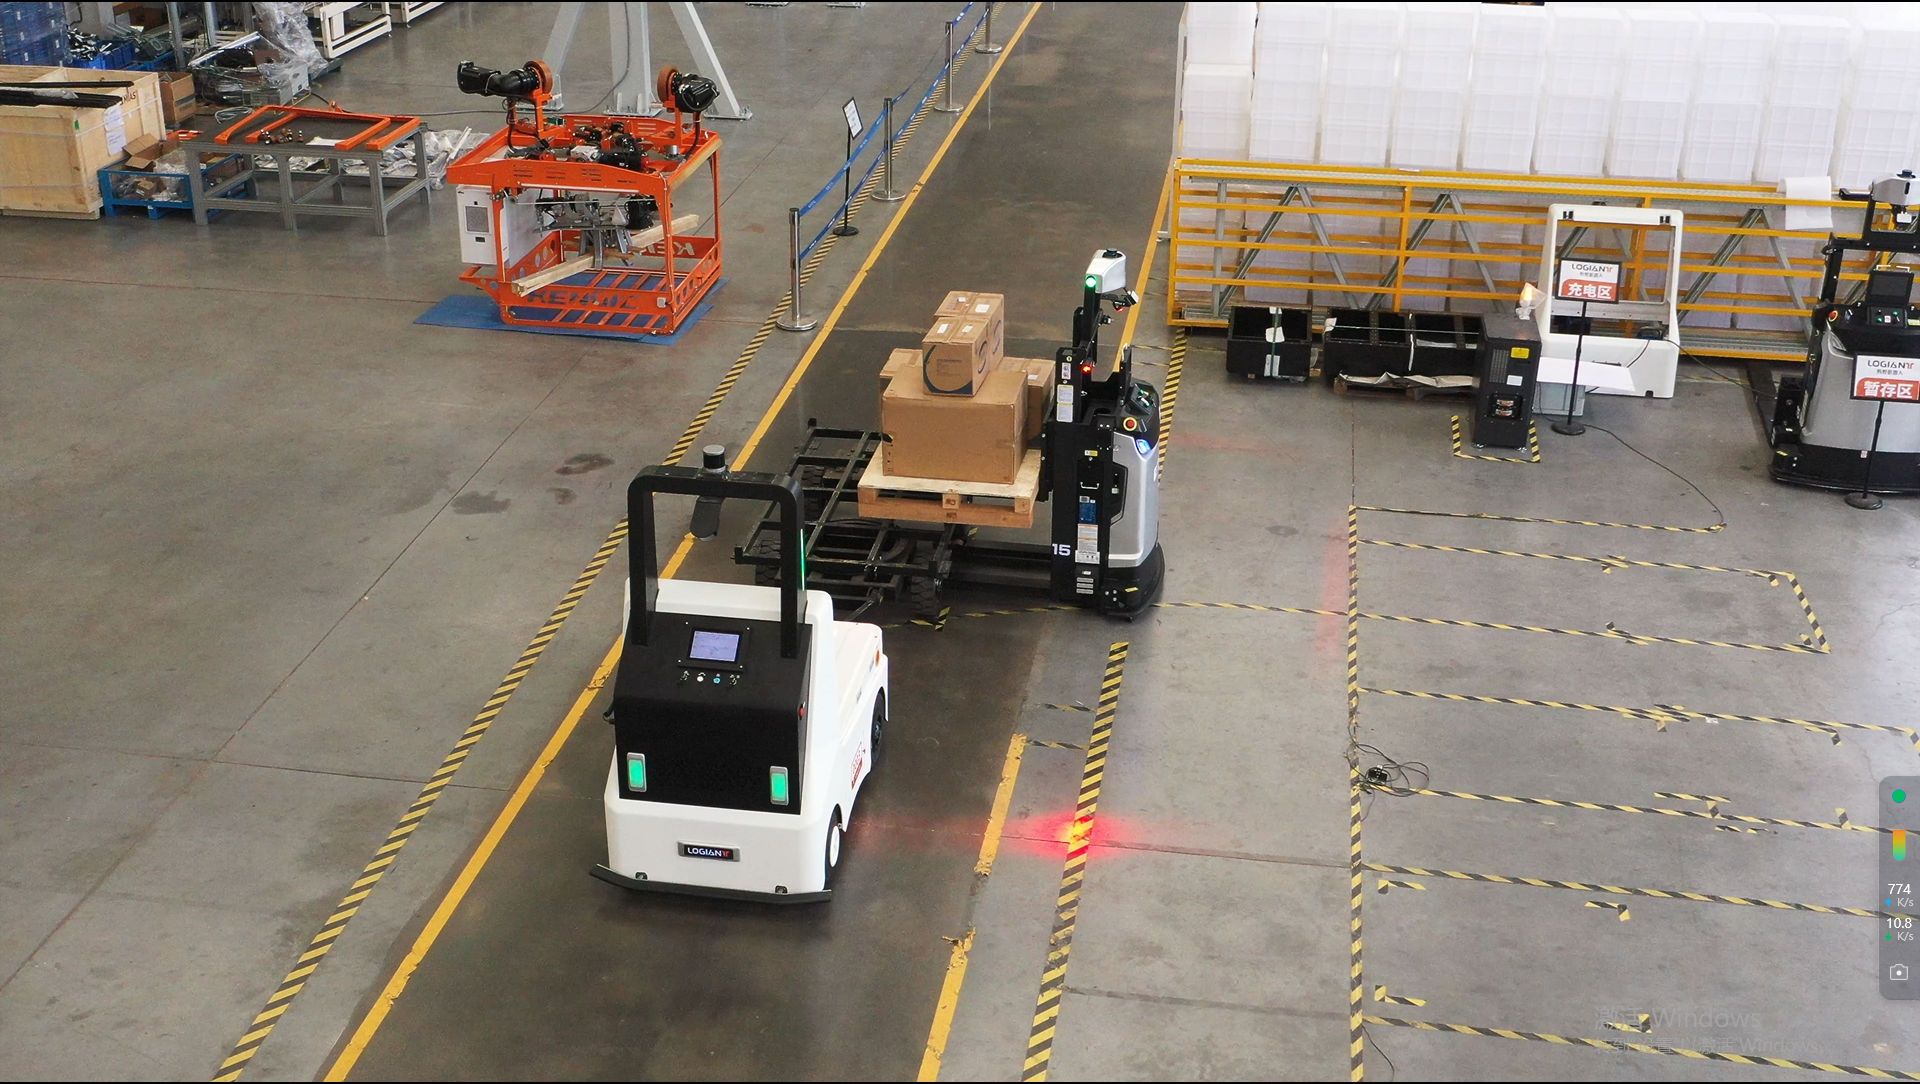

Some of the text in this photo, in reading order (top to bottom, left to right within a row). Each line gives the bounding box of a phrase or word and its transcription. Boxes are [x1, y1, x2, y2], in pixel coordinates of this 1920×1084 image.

[1567, 282, 1613, 299] 充电区
[1863, 380, 1914, 399] 暂存区
[1052, 543, 1071, 557] 15
